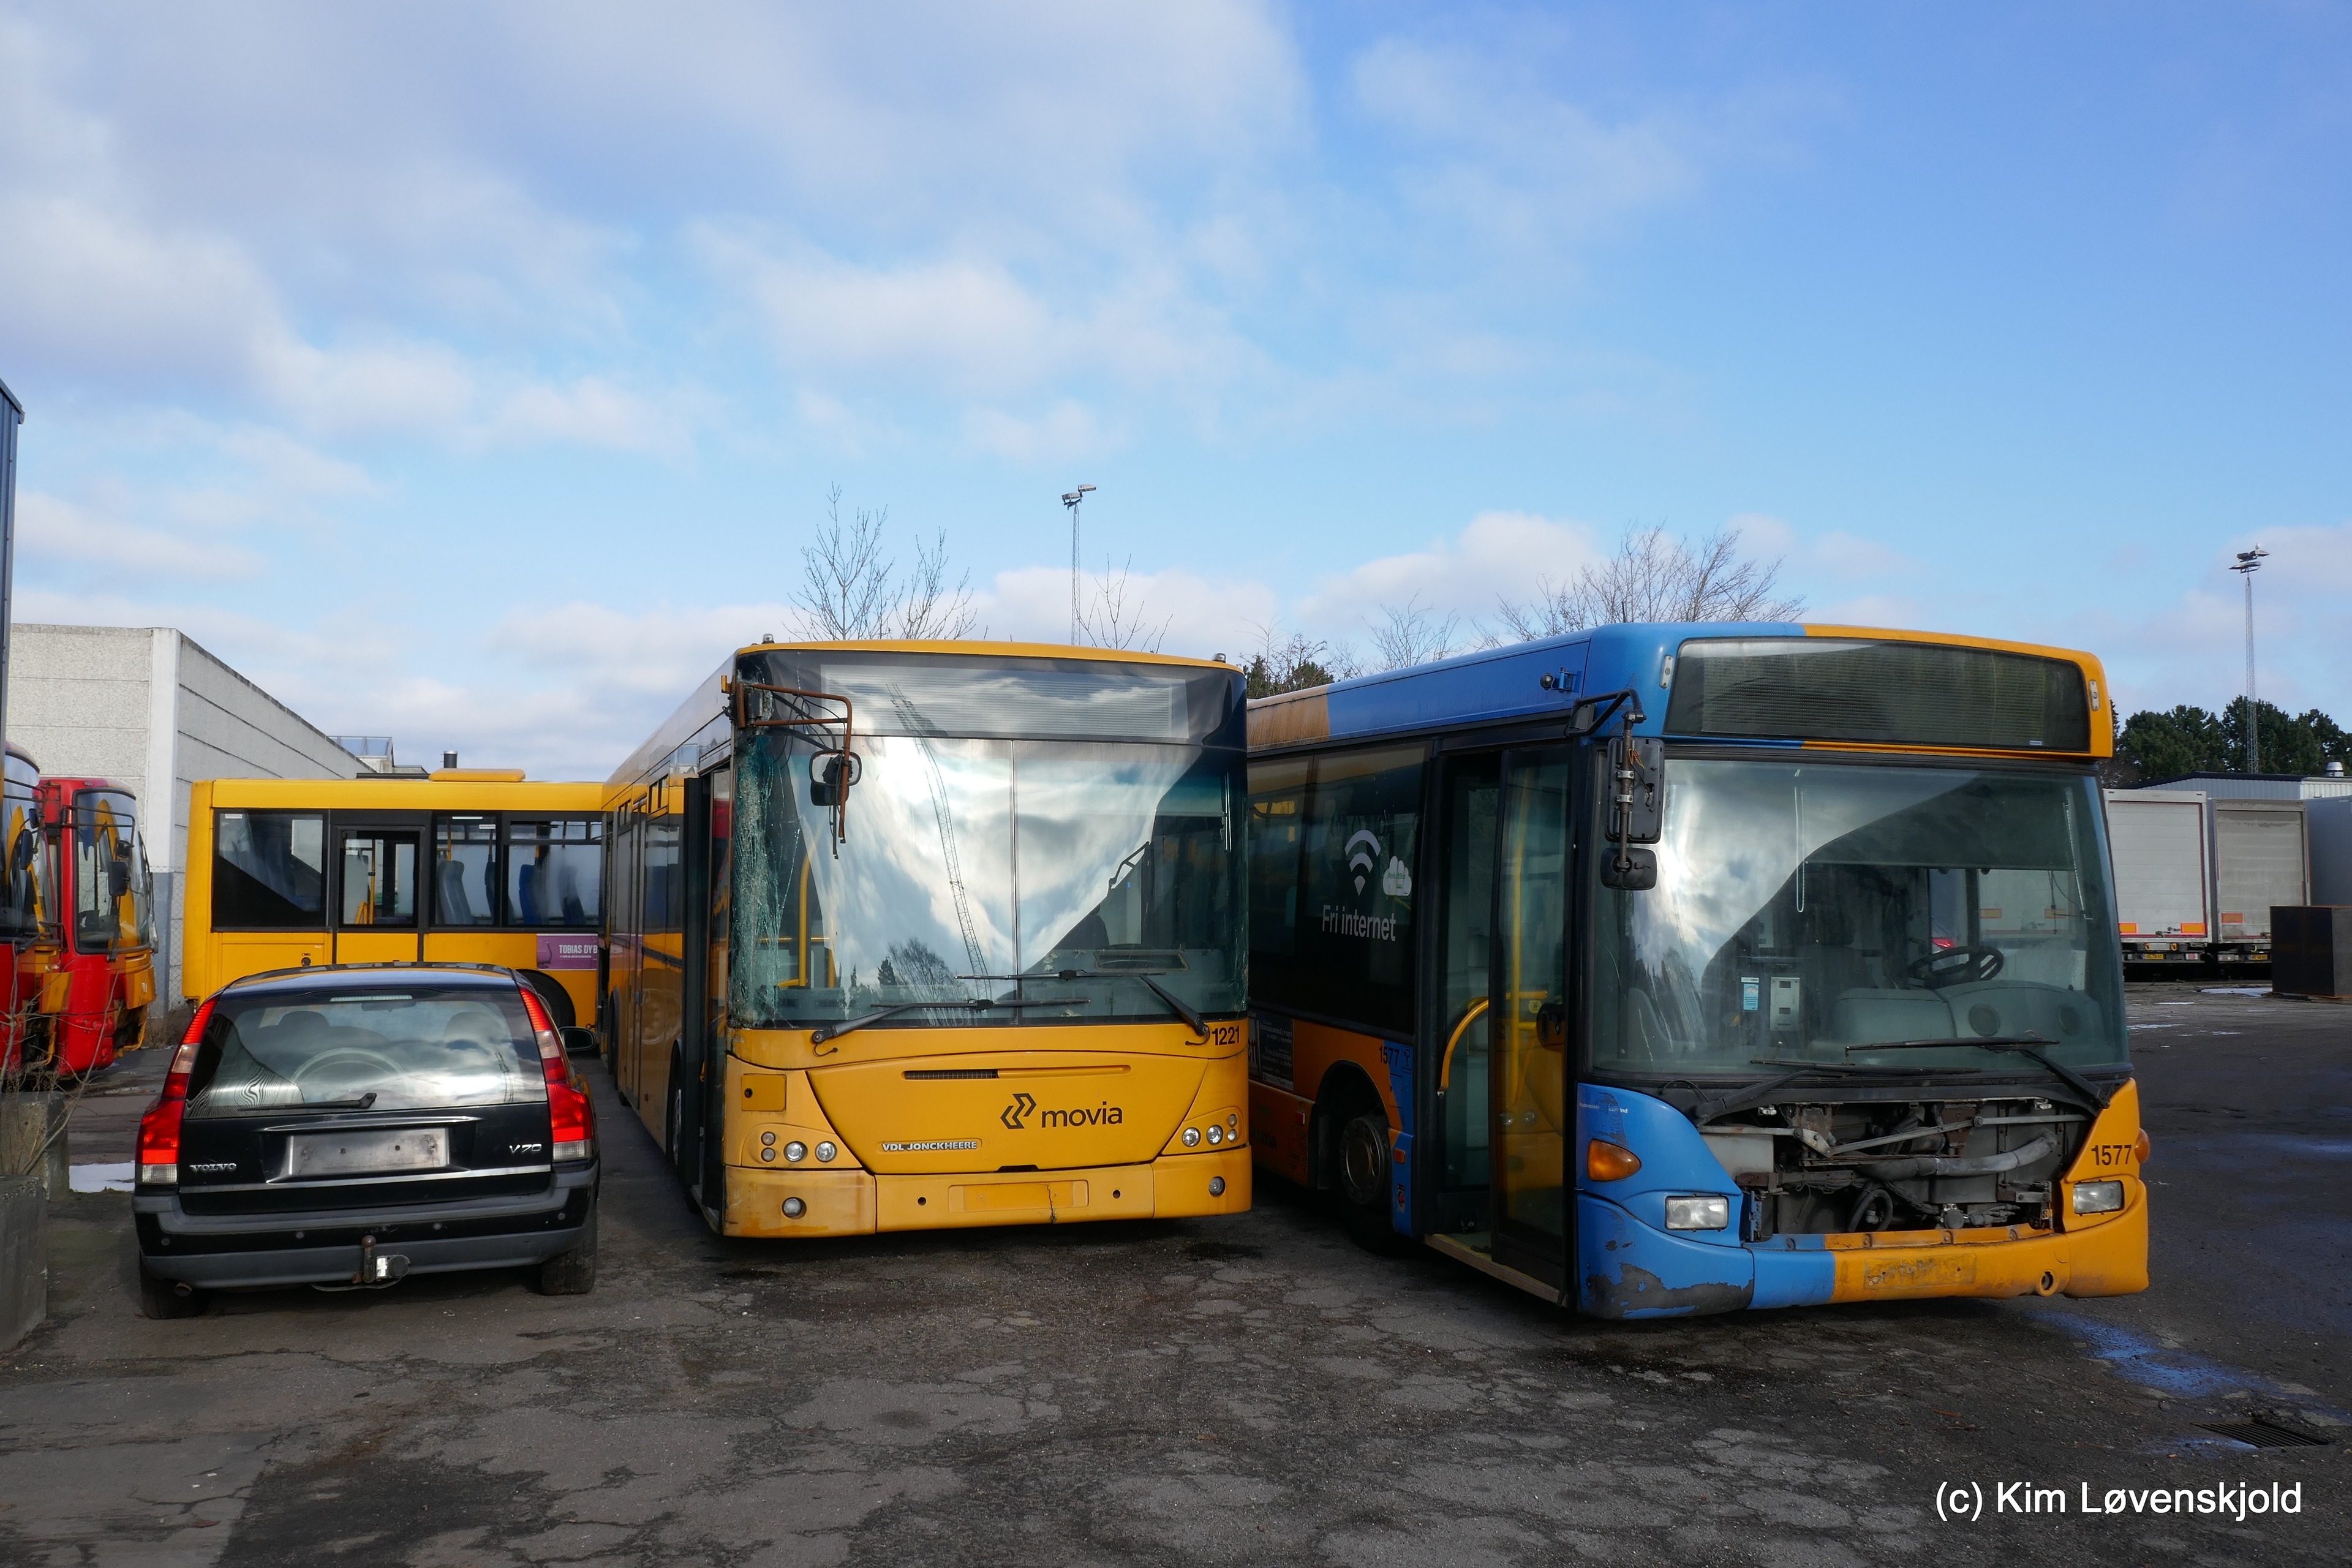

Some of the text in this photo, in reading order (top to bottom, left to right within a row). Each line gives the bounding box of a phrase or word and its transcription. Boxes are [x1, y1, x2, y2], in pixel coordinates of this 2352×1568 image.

[1322, 905, 1396, 941] Fri internet
[559, 944, 582, 954] TOBIAS
[1212, 1026, 1240, 1046] 1221
[1379, 1045, 1400, 1066] 1577
[1041, 1101, 1123, 1128] movia
[509, 1144, 542, 1153] V70
[906, 1140, 978, 1152] JONCKHEERE
[2090, 1144, 2132, 1166] 1577
[190, 1163, 237, 1172] VOLVO
